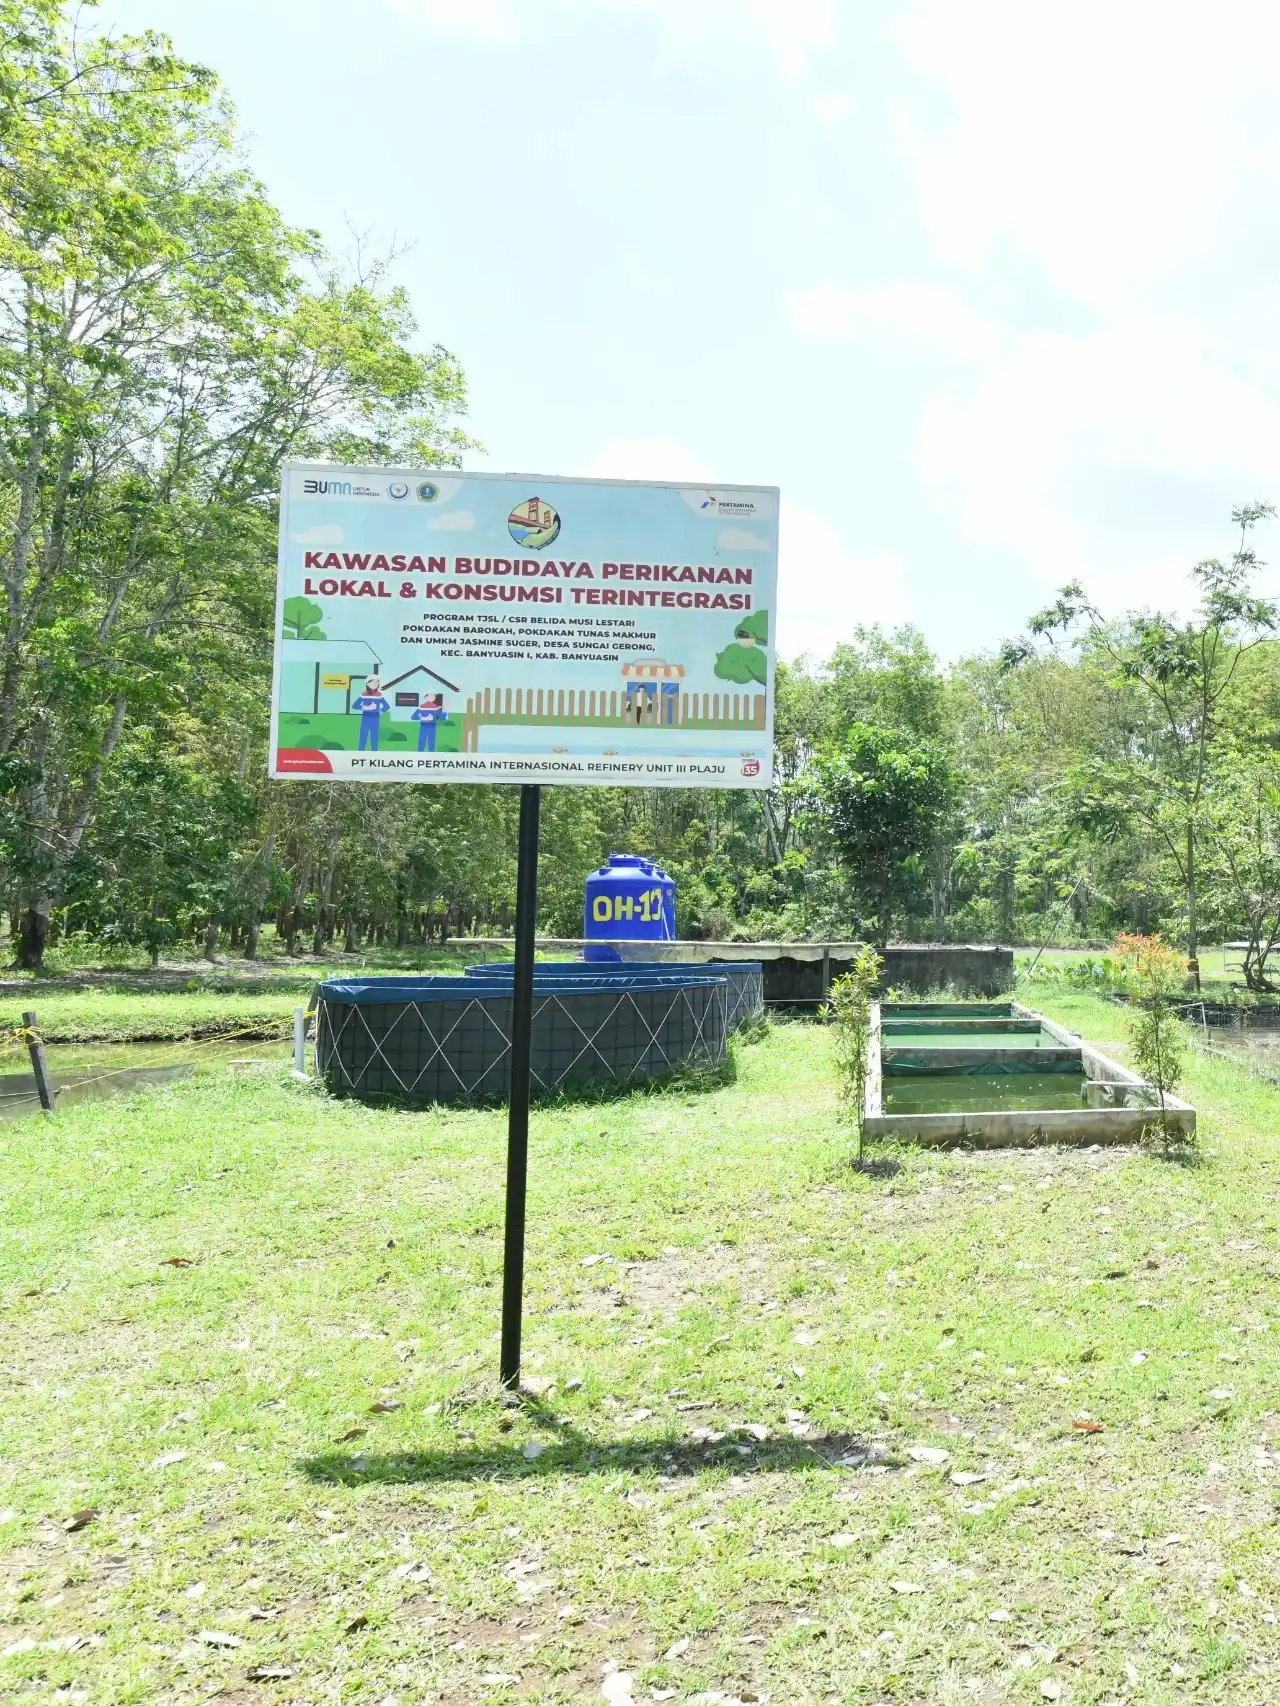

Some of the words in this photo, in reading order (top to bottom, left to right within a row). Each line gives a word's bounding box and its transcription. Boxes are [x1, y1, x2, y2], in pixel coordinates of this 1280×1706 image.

[304, 480, 351, 495] BUMN
[304, 552, 446, 573] KAWASAN
[455, 558, 594, 578] BUDIDAYA
[602, 563, 752, 584] PERIKANAN
[304, 578, 392, 598] LOKAL
[400, 582, 417, 598] &
[426, 582, 562, 603] KONSUMSI
[570, 588, 750, 610] TERINTEGRASI
[423, 614, 474, 622] PROGRAM
[502, 615, 506, 623] /
[463, 627, 515, 635] BAROKAH,
[506, 640, 540, 648] SUGER,
[612, 643, 655, 652] GERONG,
[351, 759, 366, 768] PT
[369, 759, 414, 768] KILANG
[418, 760, 486, 769] PERTAMINA
[490, 761, 584, 771] INTERNASIONAL
[587, 763, 644, 772] REFINERY
[646, 764, 673, 773] UNIT
[676, 764, 685, 773] III
[690, 765, 725, 774] PLAJU
